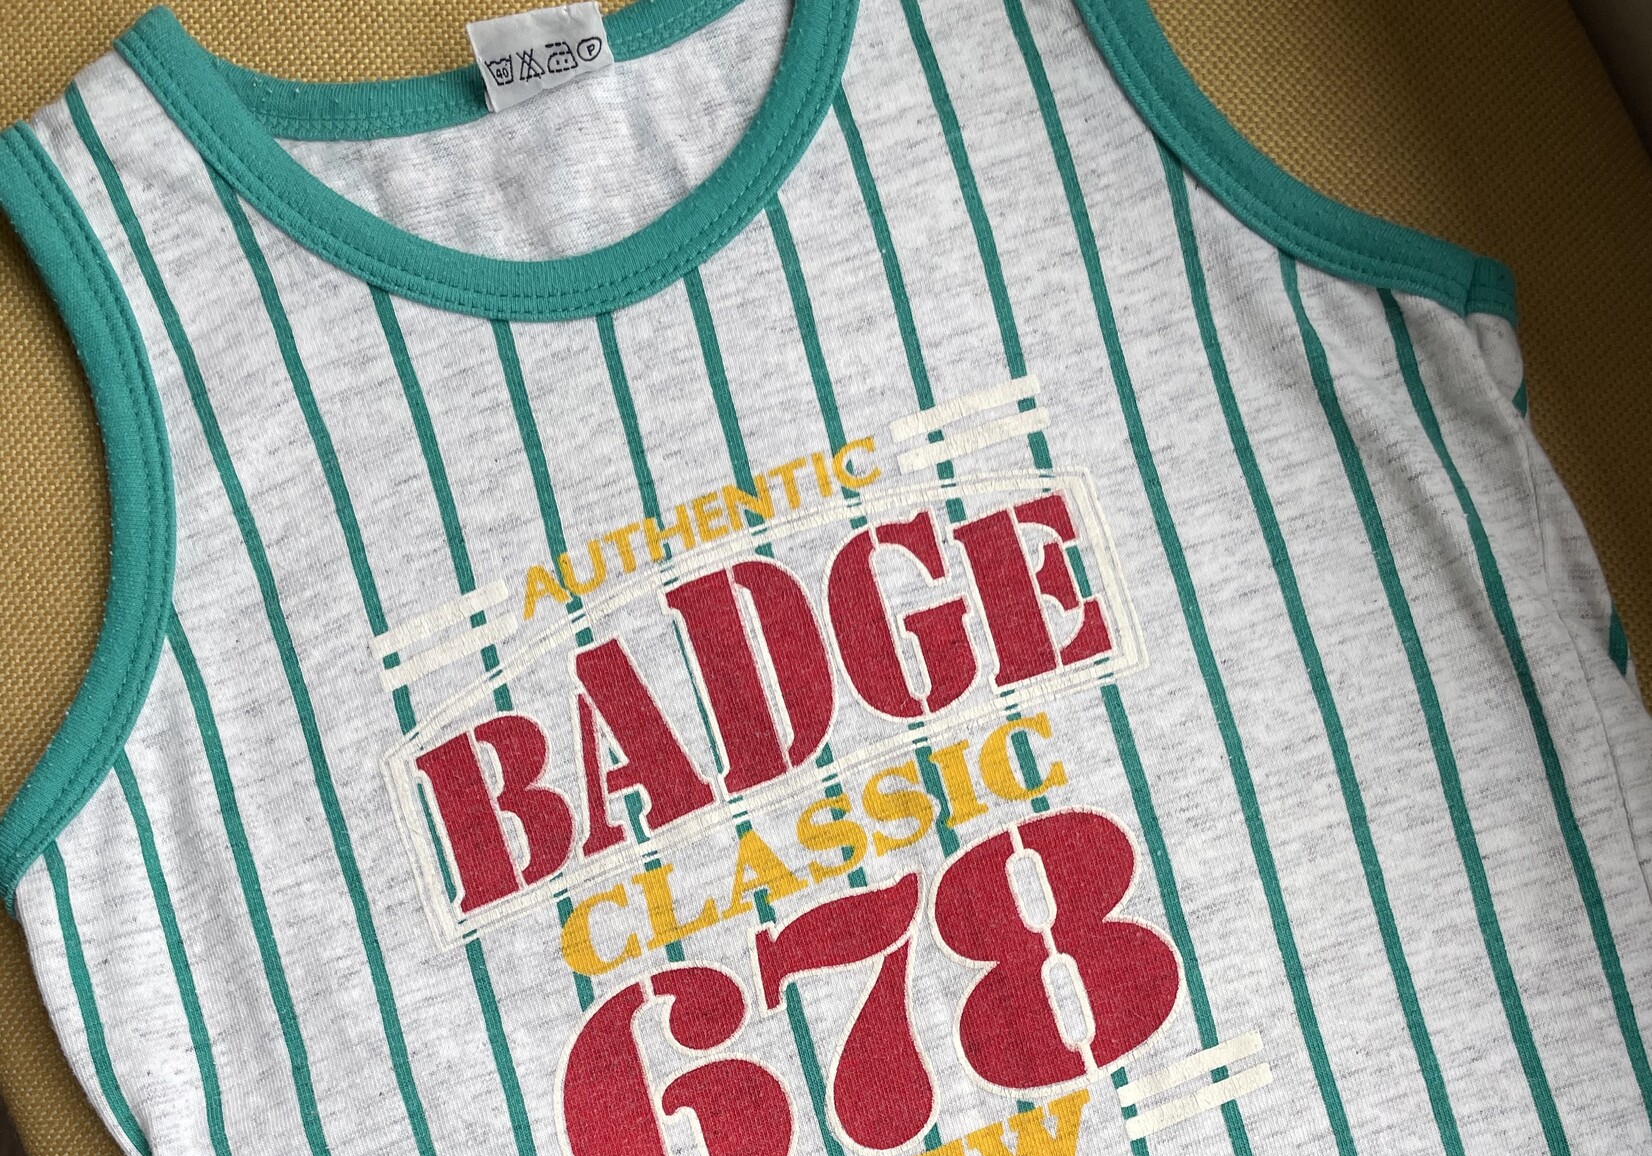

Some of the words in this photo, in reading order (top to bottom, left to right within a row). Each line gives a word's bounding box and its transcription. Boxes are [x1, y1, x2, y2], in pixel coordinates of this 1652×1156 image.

[495, 66, 509, 80] 40
[586, 43, 596, 57] P
[521, 436, 884, 620] AUTHENTIC
[415, 489, 1113, 915] BADGE
[560, 712, 1069, 977] CLASSIC
